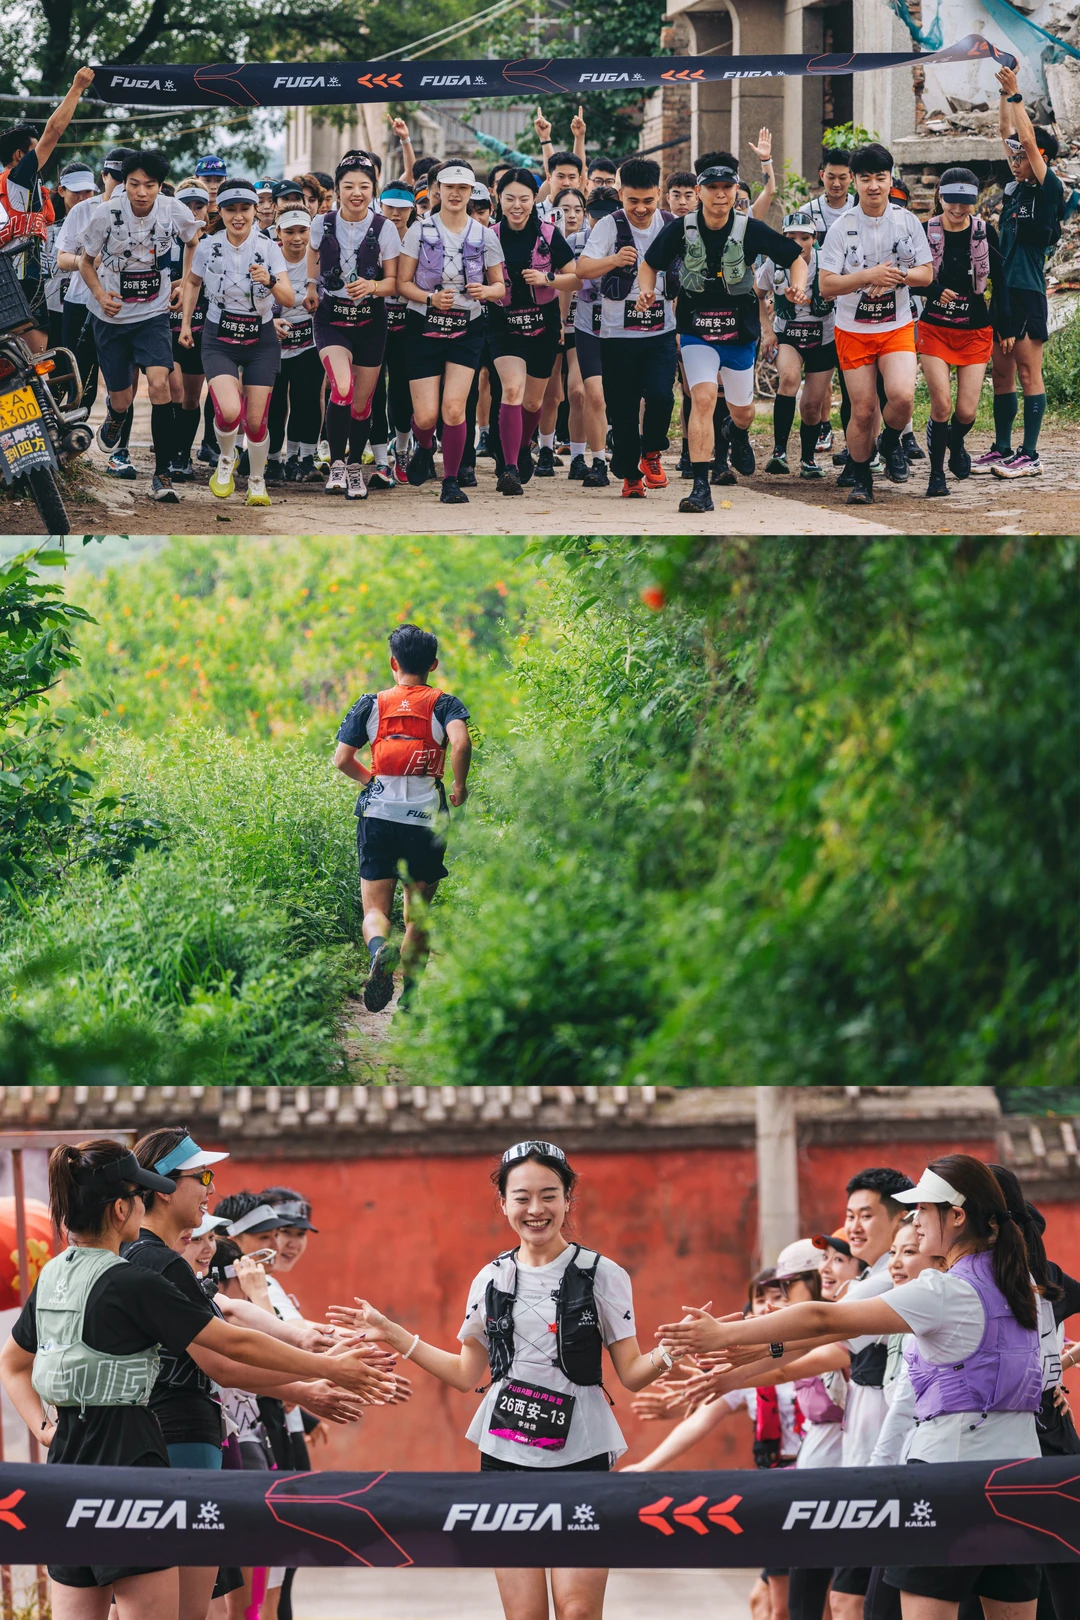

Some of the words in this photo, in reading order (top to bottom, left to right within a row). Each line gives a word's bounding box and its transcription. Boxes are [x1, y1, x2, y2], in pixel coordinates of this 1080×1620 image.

[419, 75, 471, 86] FUGA
[578, 73, 630, 83] FUGA
[723, 70, 773, 79] FUGA
[110, 75, 161, 91] FUGA
[273, 76, 325, 89] FUGA
[123, 278, 160, 290] 26西安-12
[333, 304, 371, 316] 26西安-02
[859, 301, 895, 312] 26西安-46
[427, 314, 467, 327] 26西安-32
[507, 313, 544, 325] 26西安-14
[695, 317, 736, 328] 26西安-30
[221, 320, 259, 333] 26西安-34
[3, 437, 46, 465] 到四方
[406, 809, 432, 820] FUGA
[499, 1395, 567, 1426] 26西安-13
[65, 1498, 188, 1530] FUGA
[442, 1503, 563, 1531] FUGA
[781, 1499, 900, 1530] FUGA
[192, 1522, 225, 1530] KAILAS
[567, 1523, 600, 1531] KAILAS
[904, 1520, 937, 1528] KAILAS
